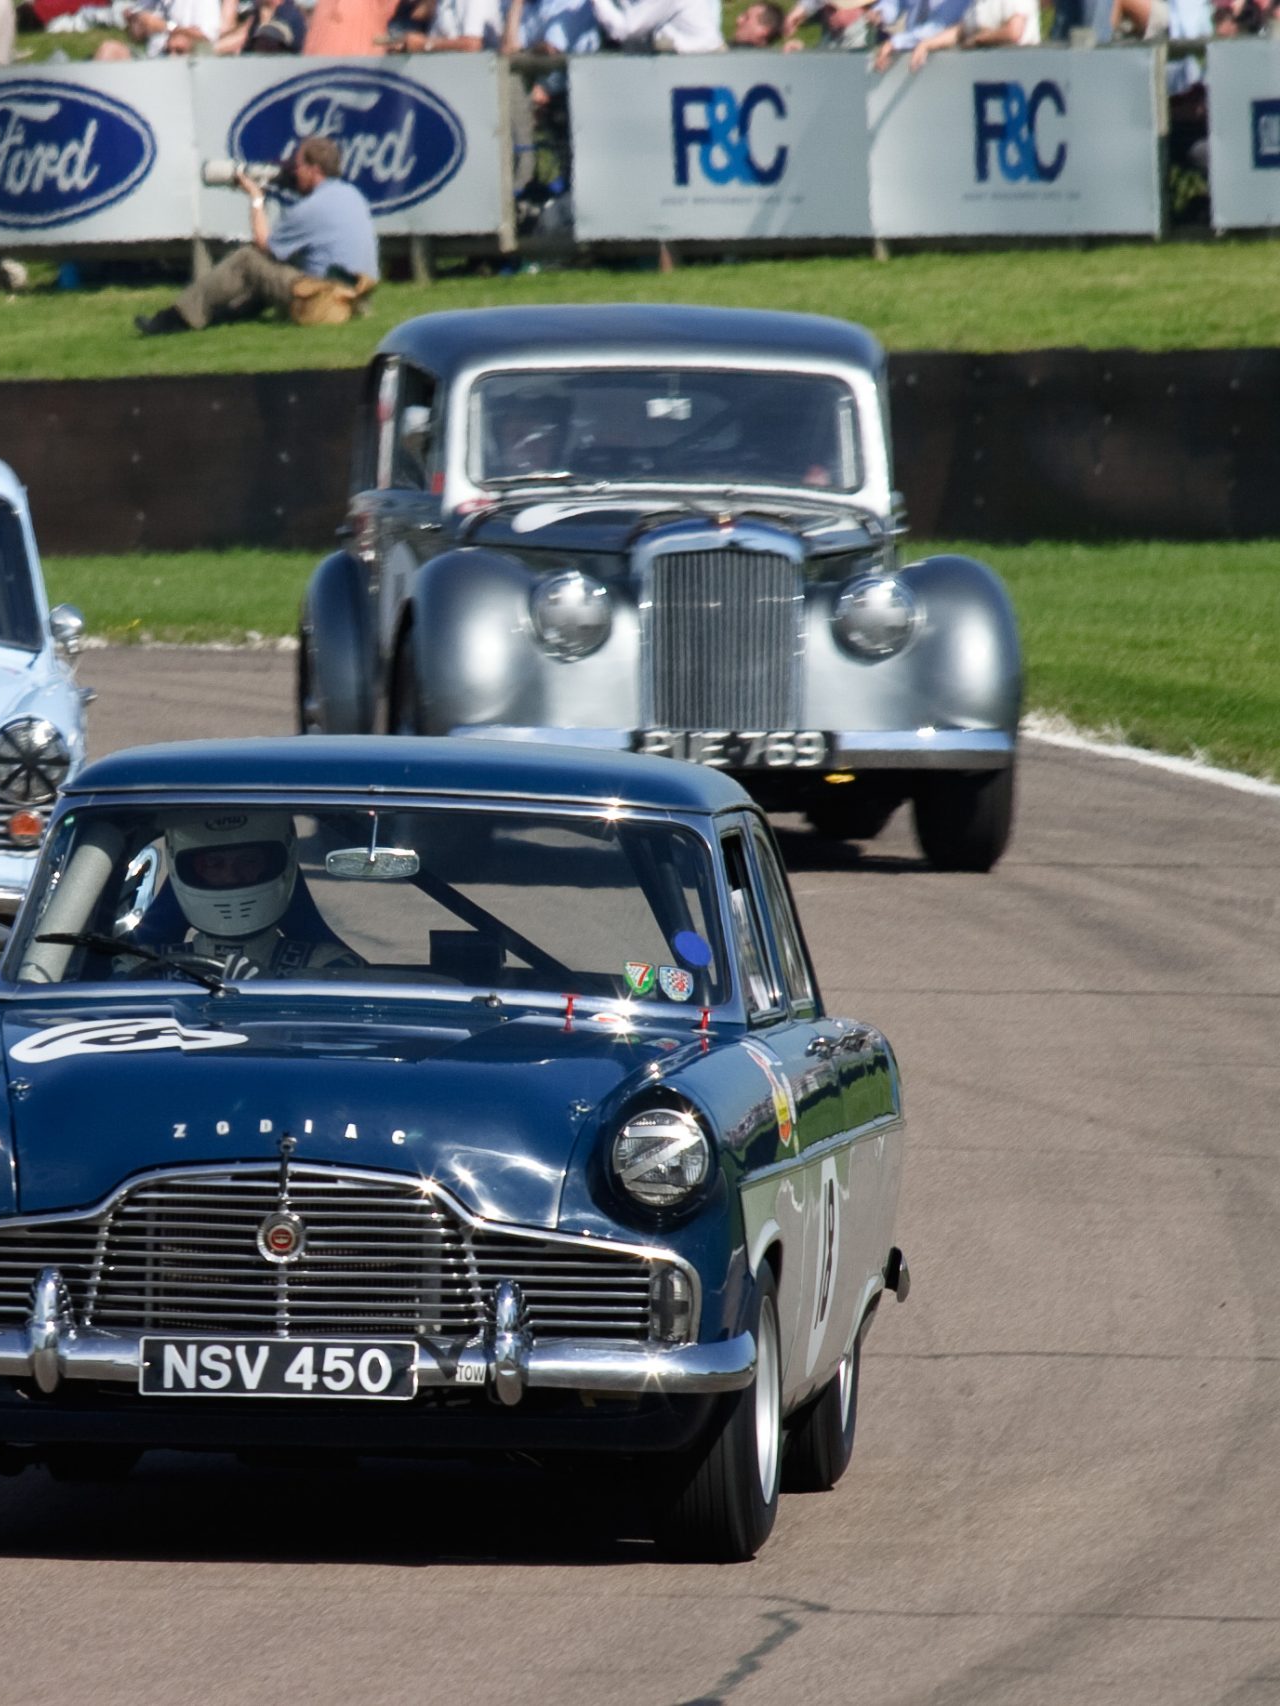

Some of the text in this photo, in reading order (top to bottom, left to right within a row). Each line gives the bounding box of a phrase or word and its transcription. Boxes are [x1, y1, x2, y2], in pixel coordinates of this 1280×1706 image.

[173, 1119, 406, 1145] ZODIAC
[163, 1344, 393, 1393] NSV 450
[458, 1364, 485, 1382] TOW
